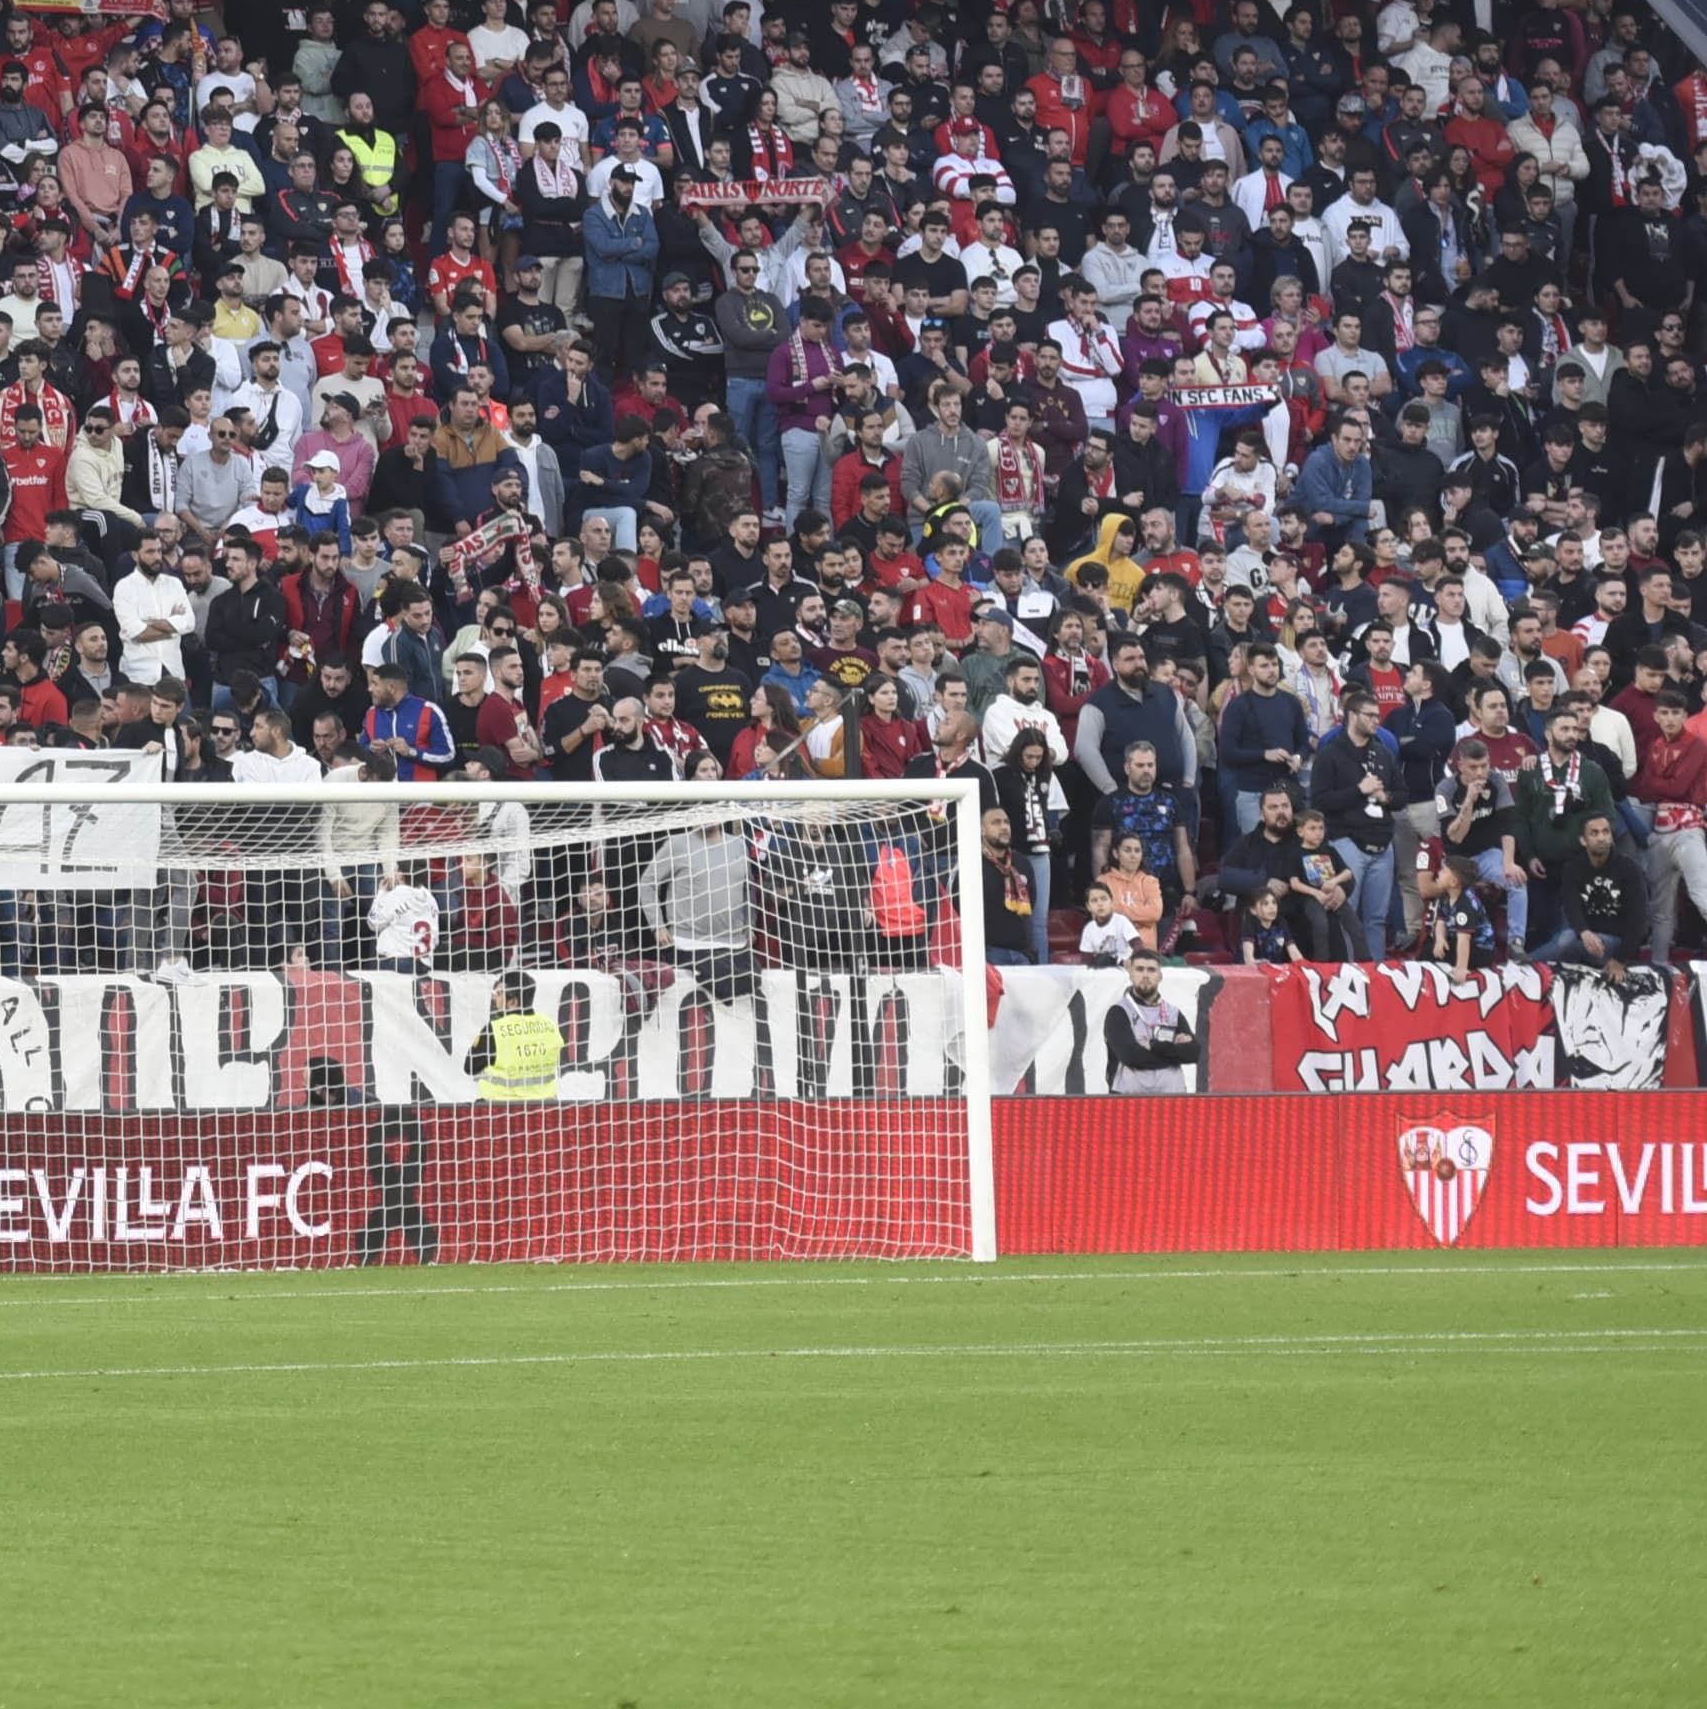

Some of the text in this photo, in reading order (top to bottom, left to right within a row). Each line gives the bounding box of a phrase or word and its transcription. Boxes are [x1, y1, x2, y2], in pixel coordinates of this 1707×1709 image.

[762, 177, 823, 198] NORTE
[1186, 388, 1222, 404] SFC
[1239, 387, 1276, 403] FANS
[15, 474, 49, 487] betfair
[412, 919, 432, 958] 3
[1296, 1030, 1556, 1091] GUARDA
[245, 1160, 335, 1240] FC
